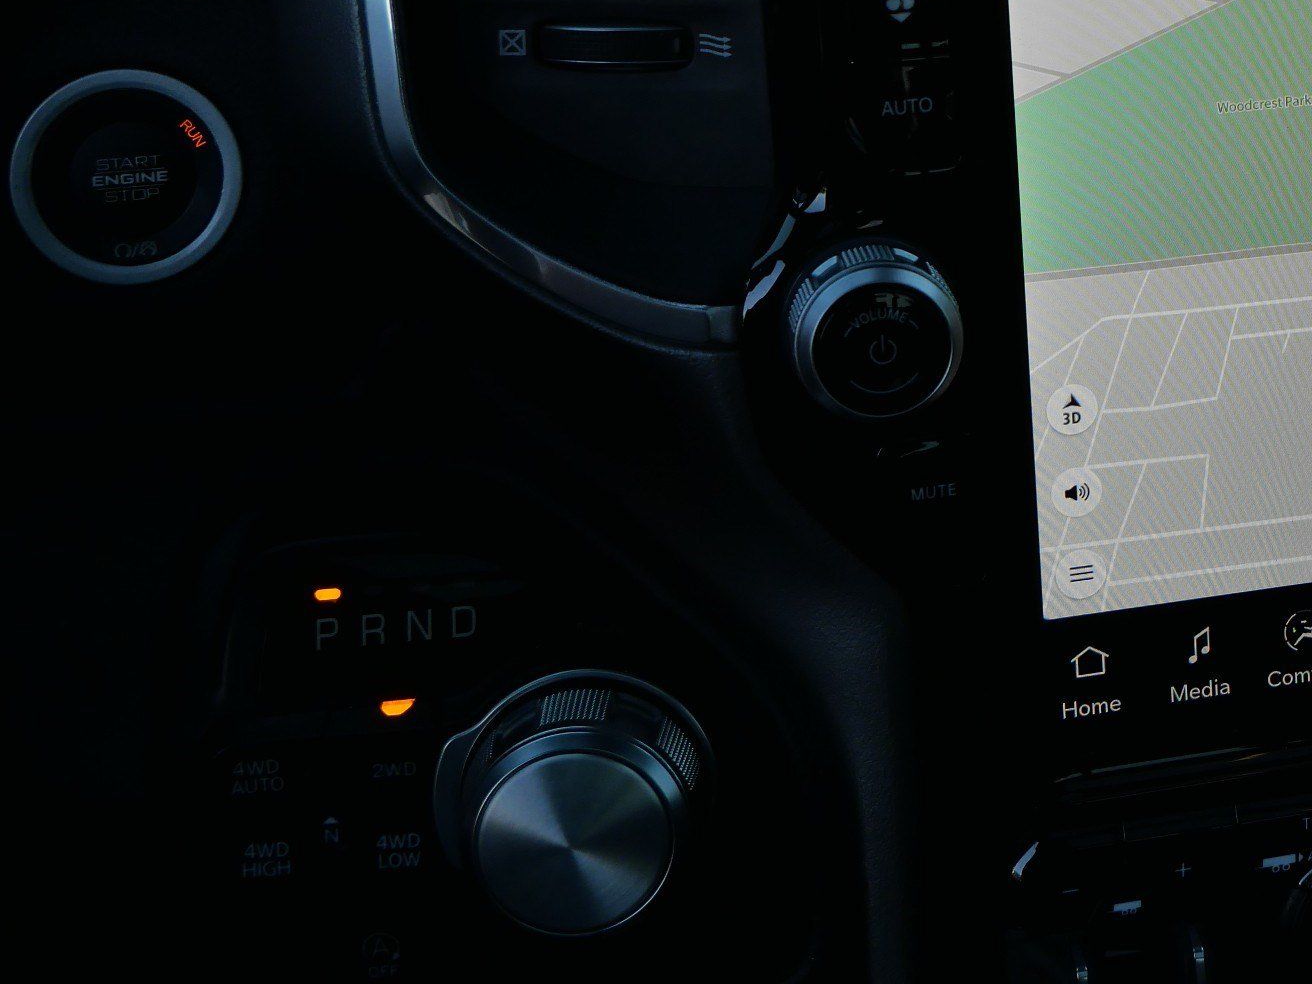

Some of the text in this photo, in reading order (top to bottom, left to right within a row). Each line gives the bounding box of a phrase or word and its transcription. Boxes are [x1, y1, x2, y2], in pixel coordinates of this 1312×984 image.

[881, 97, 934, 118] AUTO
[1217, 95, 1312, 114] Woodcrest Park
[179, 118, 207, 149] RUN
[96, 155, 160, 171] START
[92, 170, 170, 188] ENGINE
[104, 187, 160, 203] STOP
[1062, 411, 1082, 426] 3D
[911, 483, 956, 502] MUTE
[315, 605, 477, 651] P R N D
[1170, 679, 1232, 704] Media
[1062, 698, 1122, 719] Home
[232, 759, 280, 776] 4WD
[372, 762, 417, 778] 2WD
[232, 777, 285, 795] AUTO
[245, 841, 289, 858] 4WD
[376, 832, 421, 850] 4WD
[241, 860, 292, 879] HIGH
[378, 853, 422, 869] LOW
